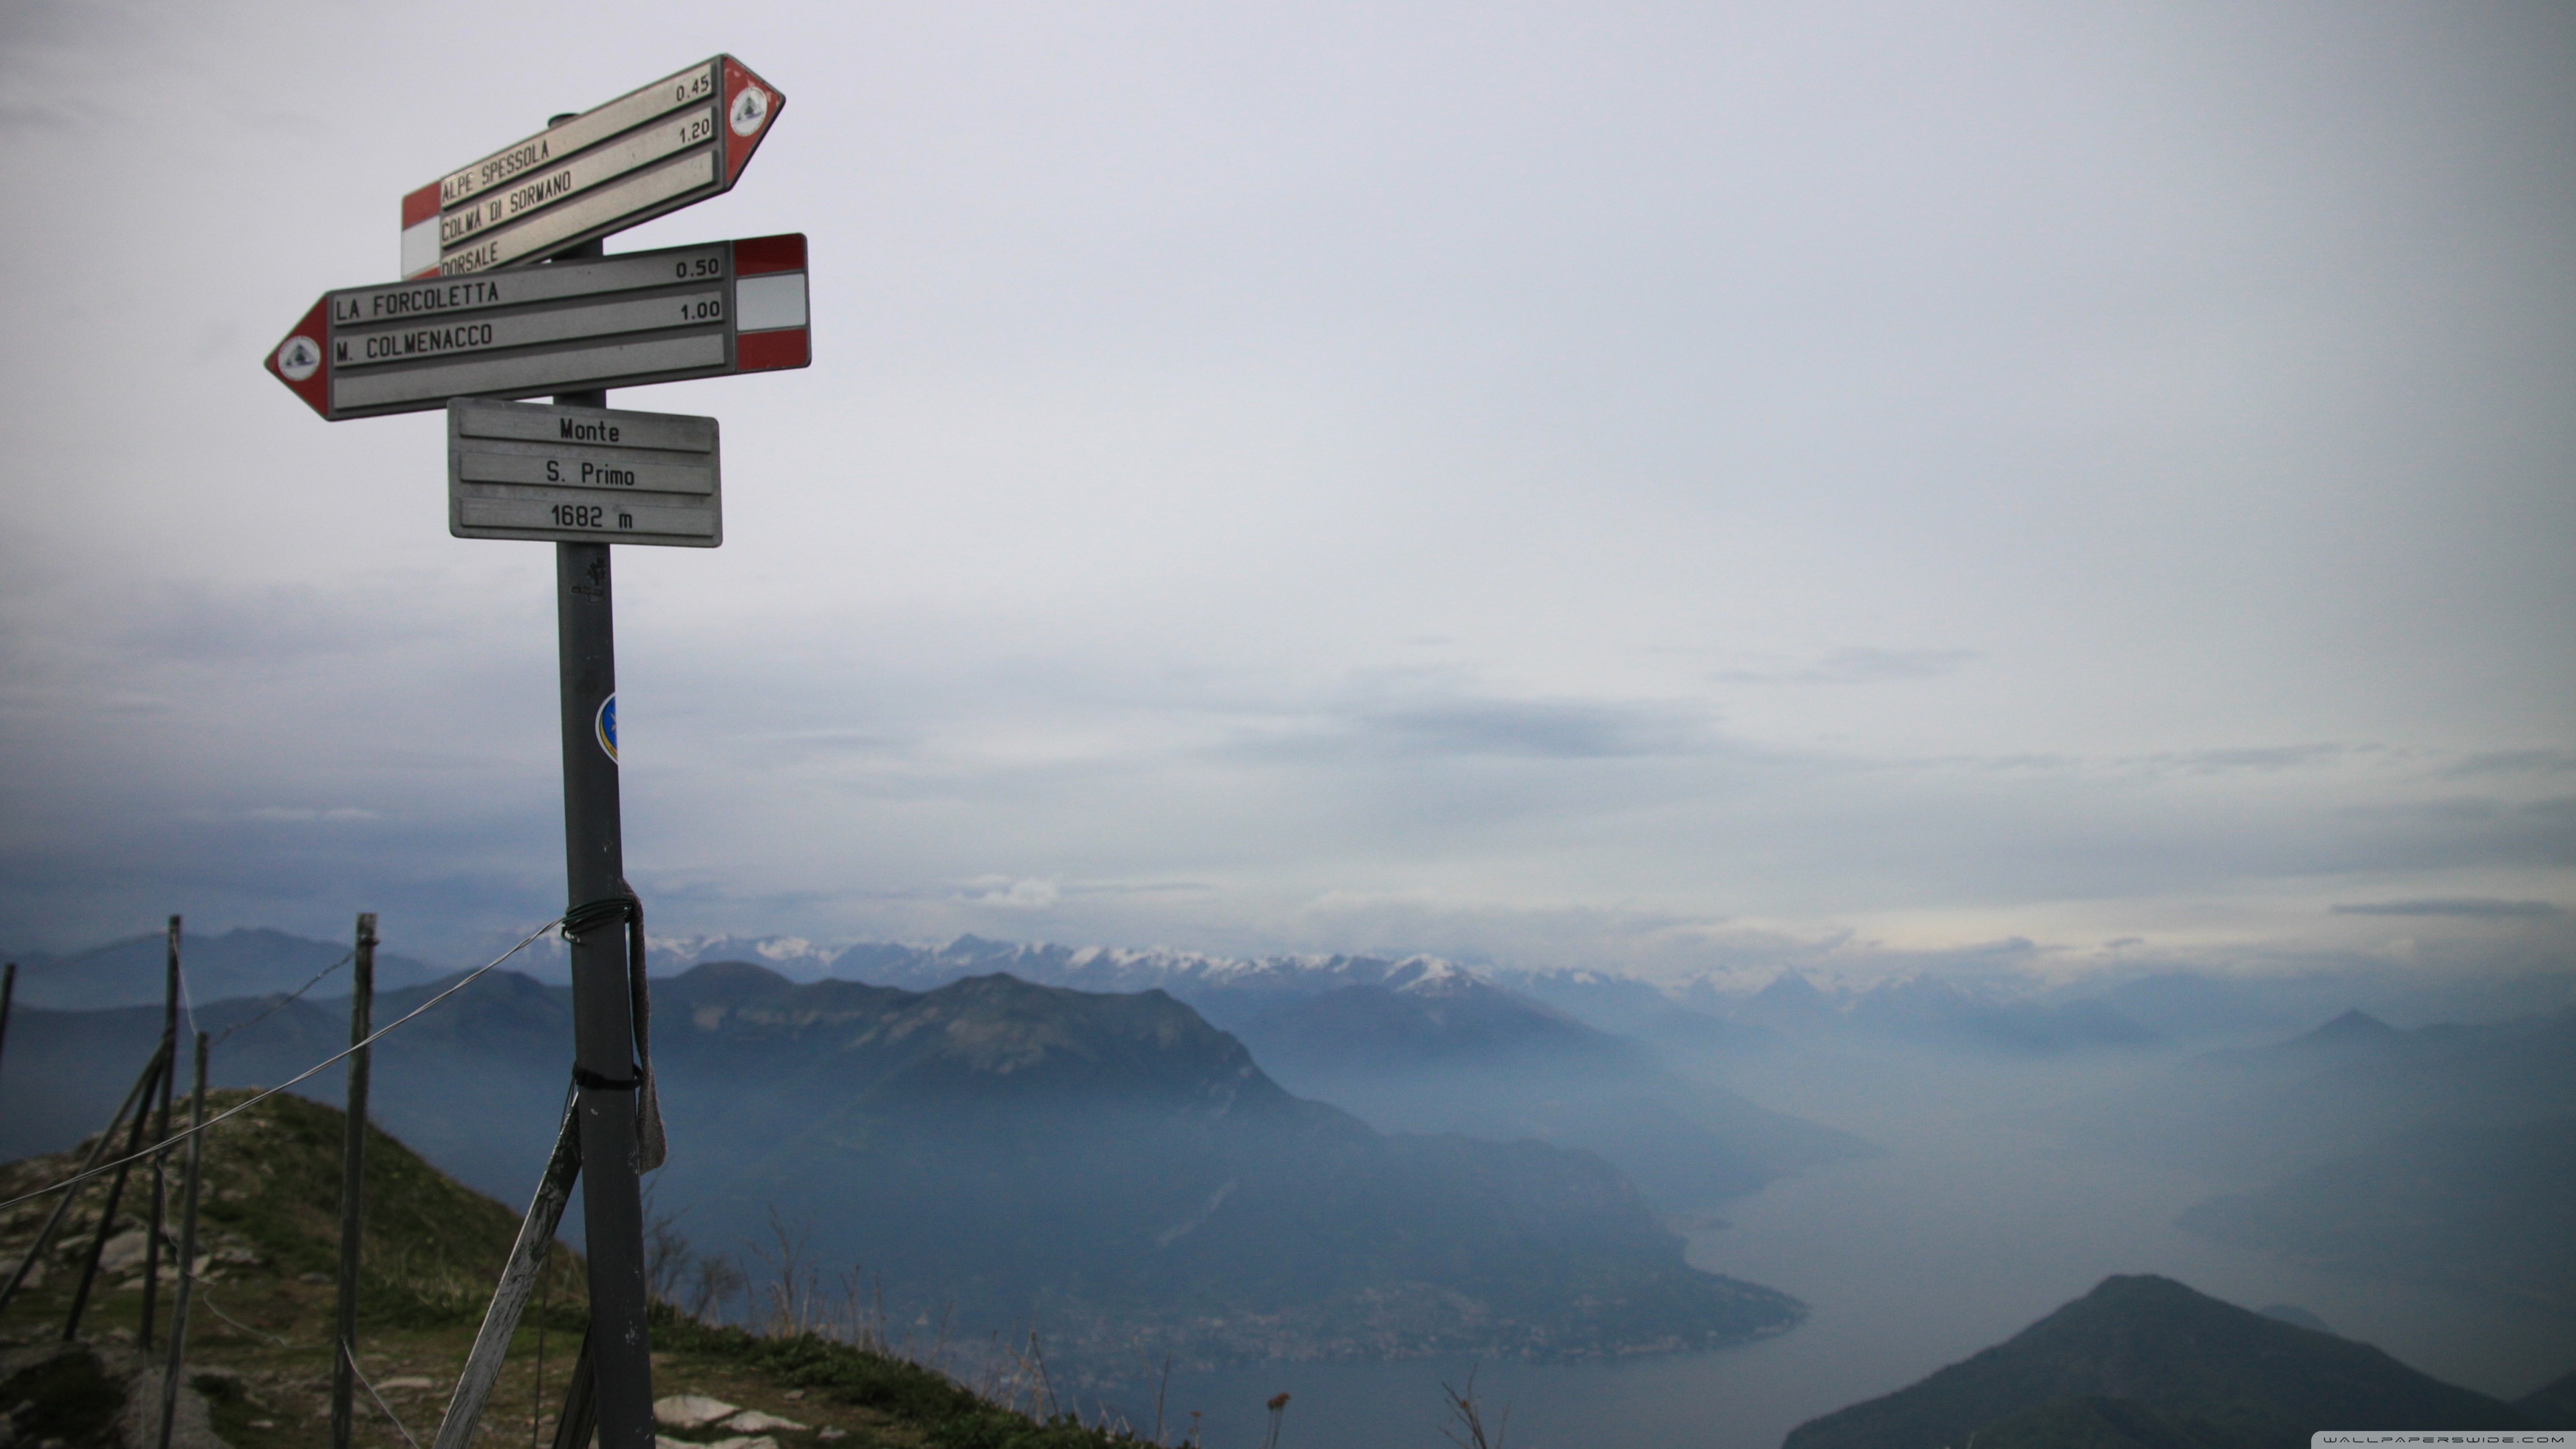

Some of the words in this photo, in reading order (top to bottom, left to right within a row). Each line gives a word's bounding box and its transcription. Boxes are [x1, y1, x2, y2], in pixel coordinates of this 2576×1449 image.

[442, 172, 473, 202] ALPE
[482, 139, 549, 185] SPESSOLA
[676, 74, 710, 101] 0.45
[441, 205, 482, 241] COLMA
[490, 200, 502, 222] DI
[511, 170, 571, 213] SORMANO
[680, 118, 710, 144] 1.20
[442, 241, 498, 276] DORSALE
[336, 299, 360, 321] LA
[374, 281, 498, 316] FORCOLETTA
[676, 258, 719, 278] 0.50
[337, 341, 354, 362] M.
[367, 324, 492, 359] COLMENACCO
[681, 301, 720, 320] 1.00
[560, 417, 619, 442] Monte
[547, 460, 566, 482] S.
[582, 462, 635, 486] Primo
[551, 504, 602, 528] 1682
[619, 513, 633, 529] m
